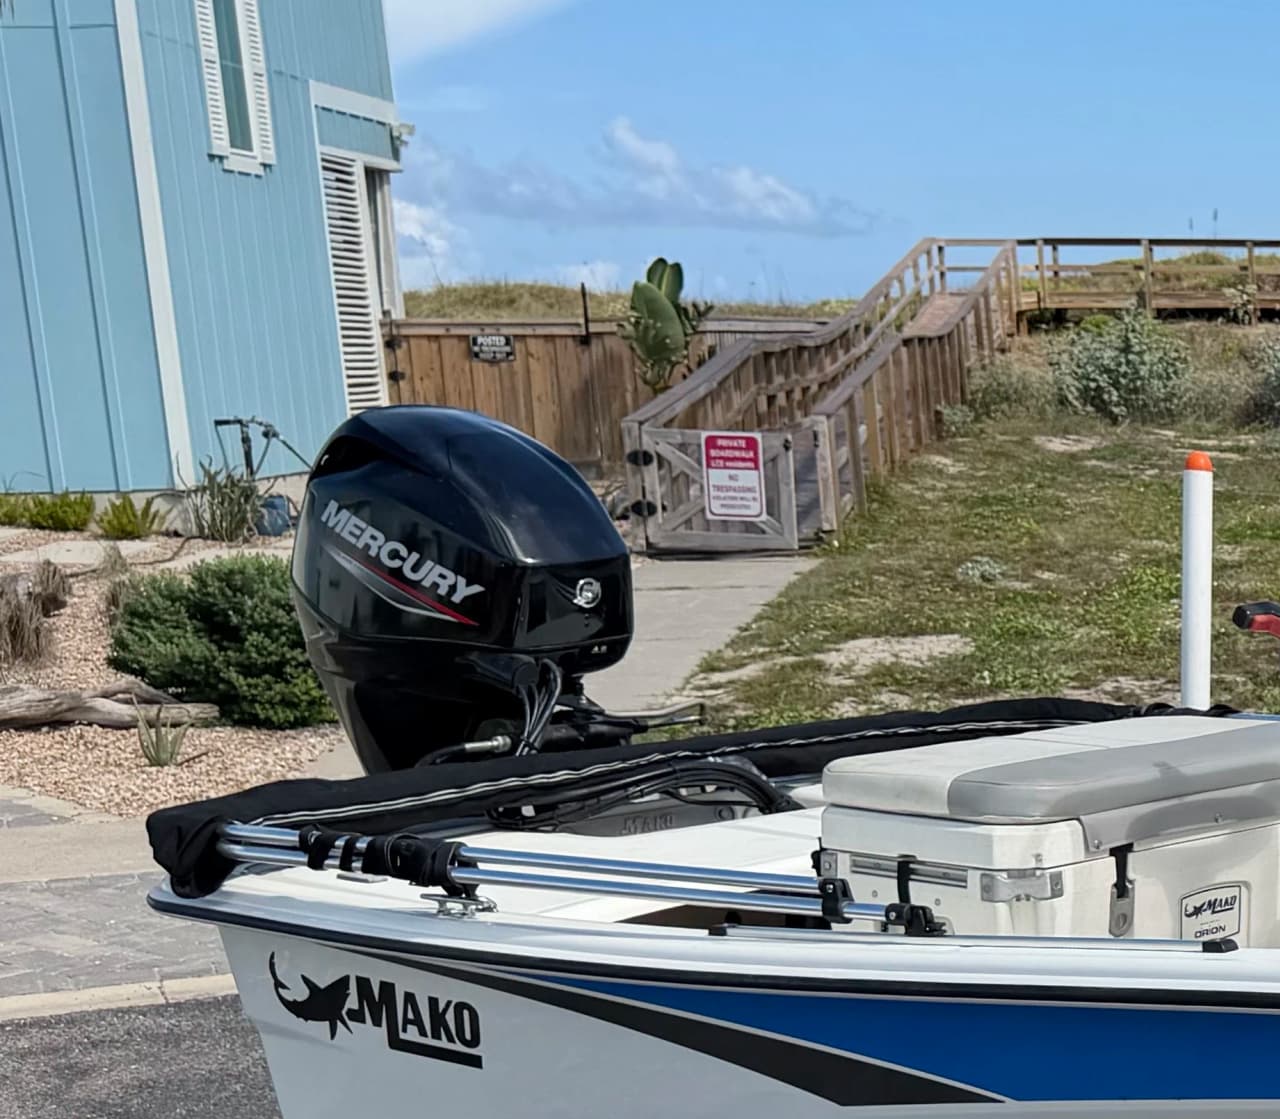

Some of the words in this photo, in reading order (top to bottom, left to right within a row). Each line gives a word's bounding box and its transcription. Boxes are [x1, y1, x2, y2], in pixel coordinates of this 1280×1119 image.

[717, 438, 746, 448] PRIVATE
[321, 500, 486, 604] MERCURY
[1202, 894, 1238, 915] MAKO
[1194, 924, 1227, 939] ORION
[346, 974, 484, 1070] MAKO
